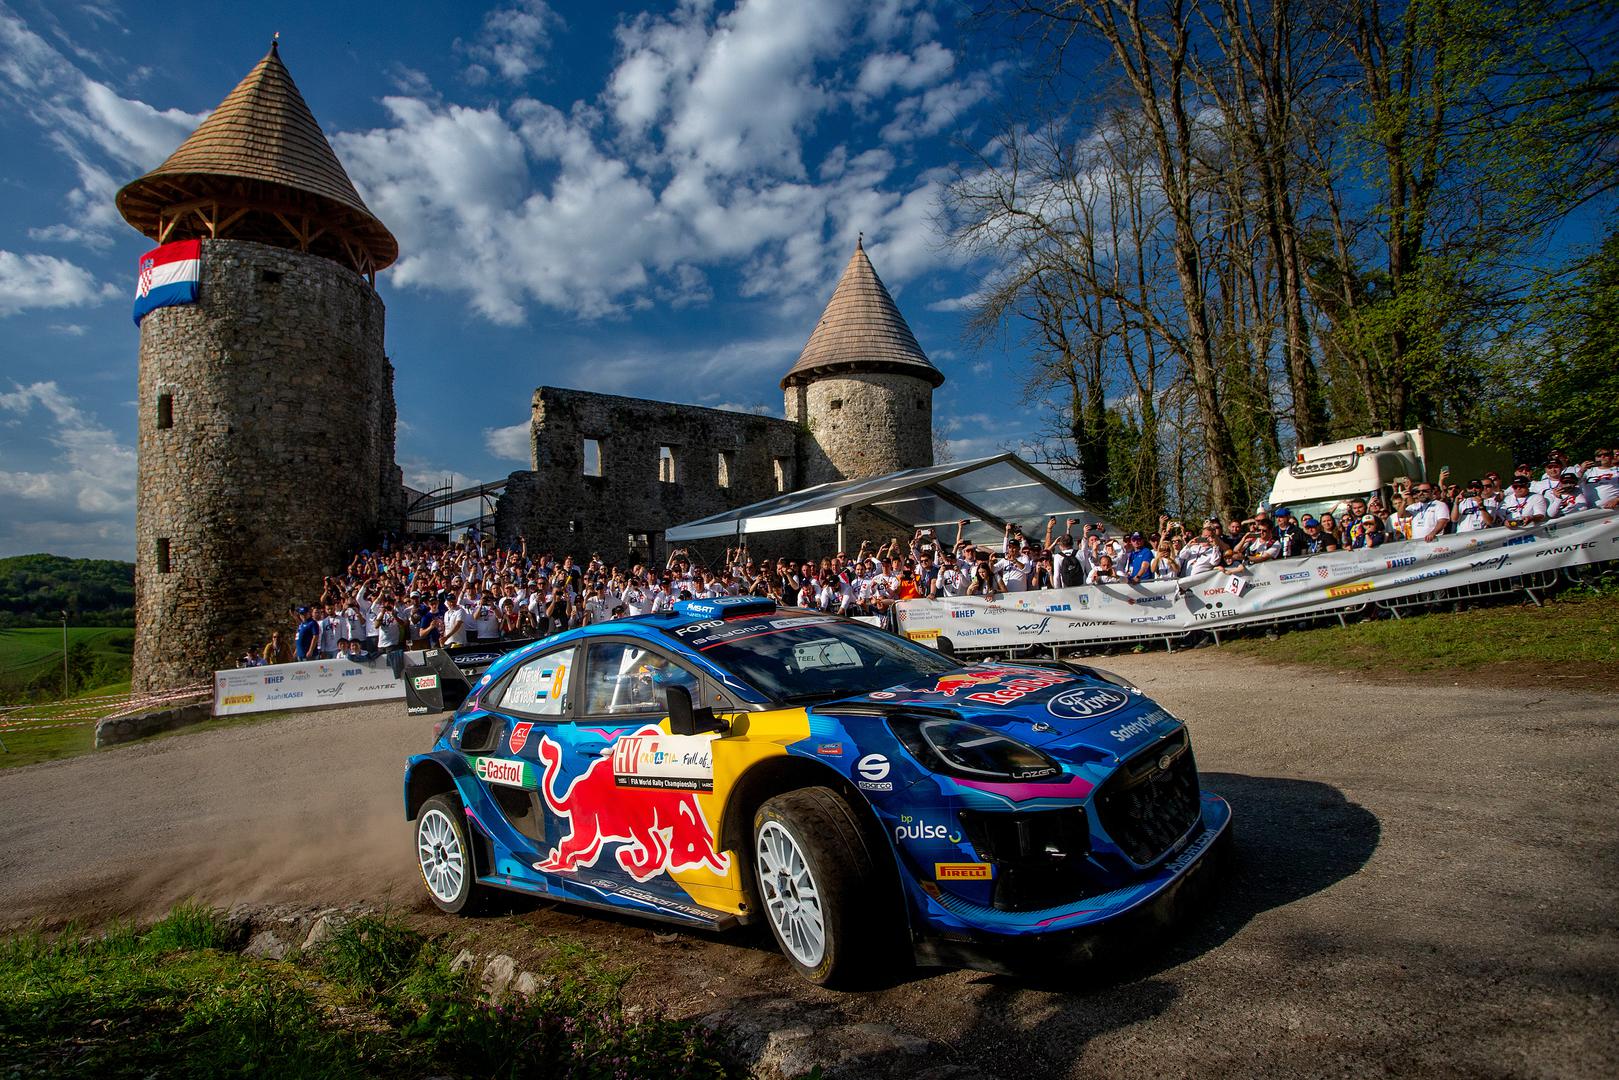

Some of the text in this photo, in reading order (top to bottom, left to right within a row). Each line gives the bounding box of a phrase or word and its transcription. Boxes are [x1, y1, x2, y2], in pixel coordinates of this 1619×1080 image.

[1536, 540, 1597, 558] FANATEC
[1397, 556, 1416, 568] HEP
[1137, 595, 1166, 604] SUZUKI
[959, 609, 975, 618] HEP
[1193, 608, 1239, 620] TW STEEL
[675, 620, 725, 637] FORD
[1068, 620, 1117, 628] FANATEC
[358, 683, 397, 692] FANATEC
[552, 664, 566, 700] 8
[1058, 690, 1121, 714] Ford
[1110, 709, 1169, 742] SafetyCulture
[683, 752, 698, 765] Full
[487, 761, 521, 782] Castrol
[665, 780, 697, 789] Championship
[901, 814, 913, 824] bp
[895, 820, 947, 844] pulse
[940, 866, 986, 877] PIRELLI
[677, 904, 719, 920] HYBRID
